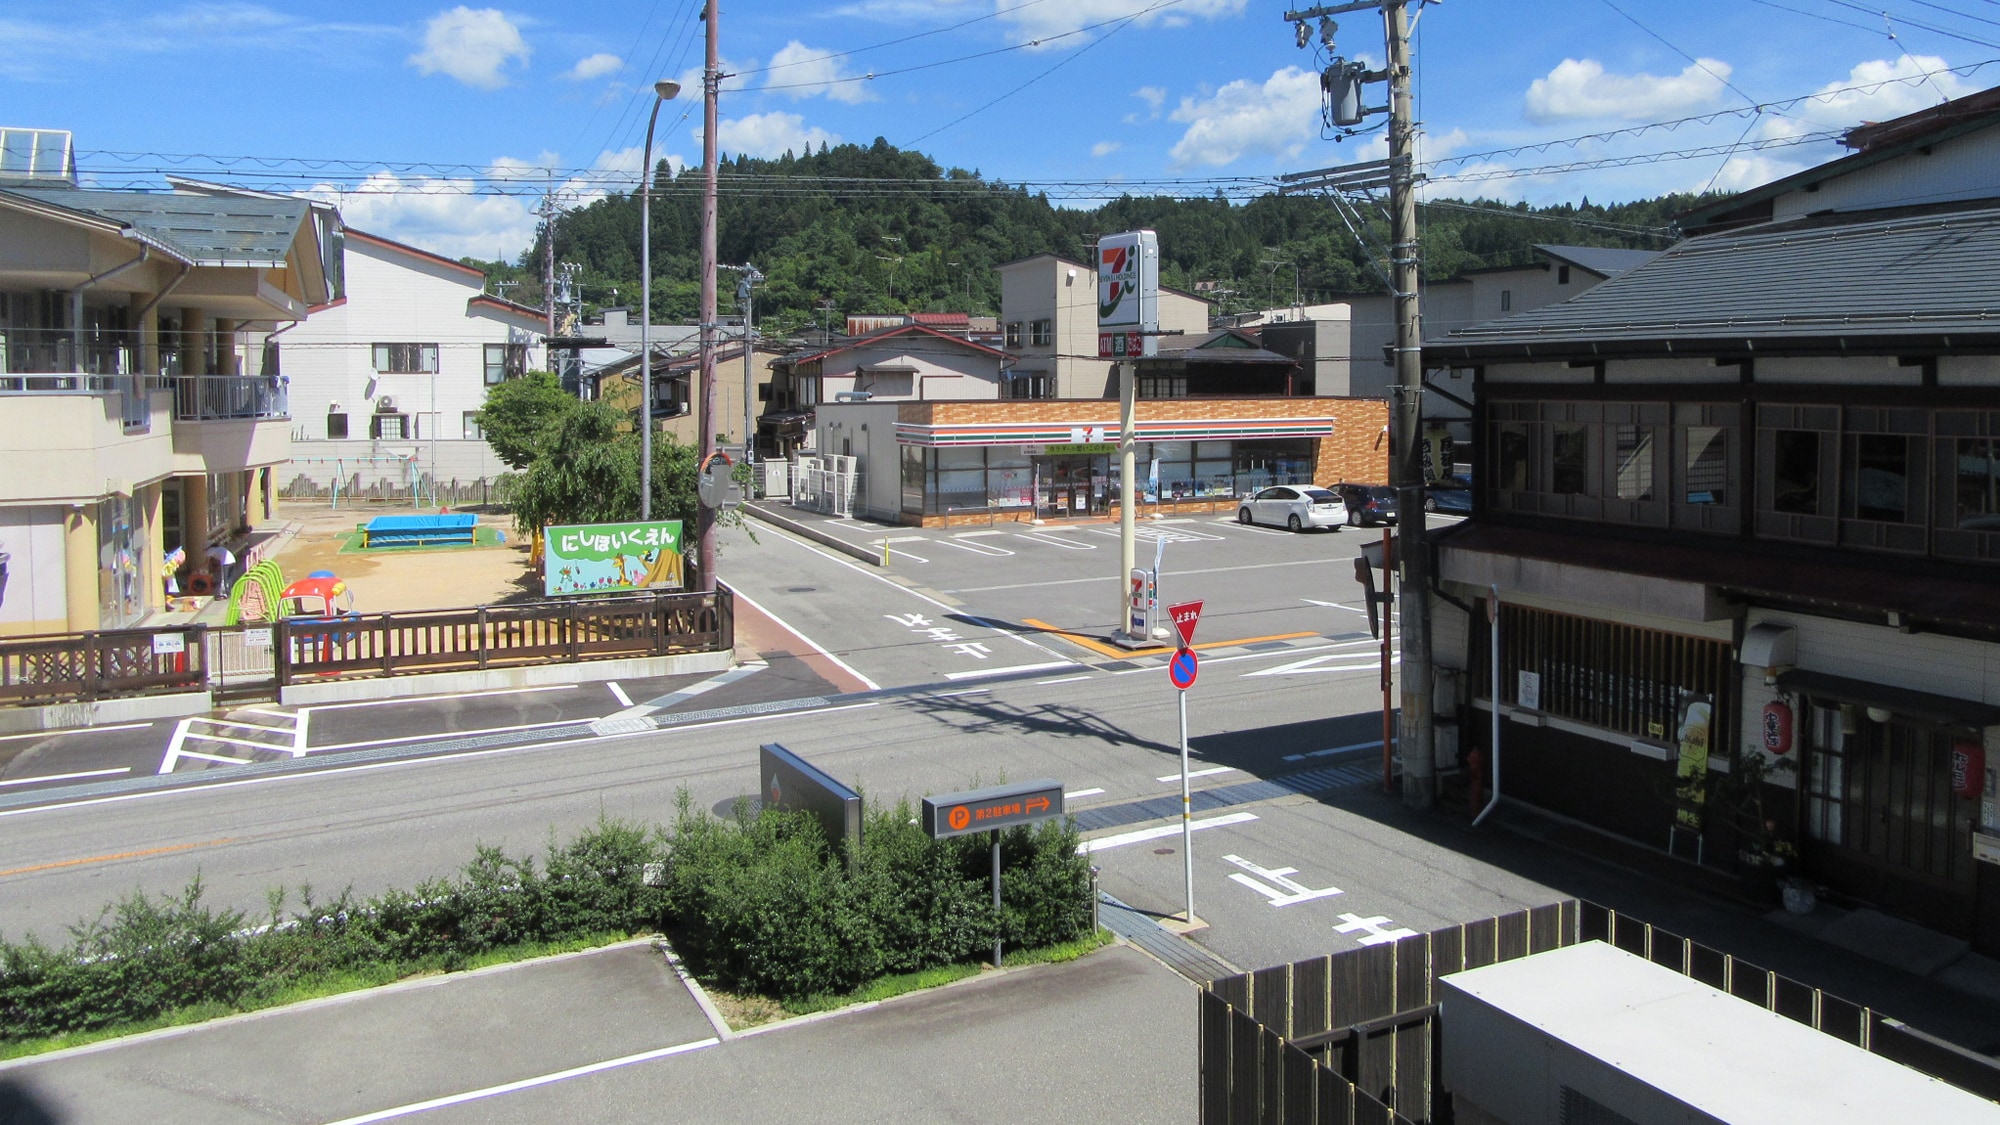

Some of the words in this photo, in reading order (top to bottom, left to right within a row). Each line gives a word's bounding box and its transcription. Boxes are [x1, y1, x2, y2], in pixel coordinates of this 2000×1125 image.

[1100, 337, 1112, 353] ATM
[1115, 336, 1125, 353] 酒
[561, 527, 675, 553] にしほいくえん
[1131, 578, 1142, 606] 7
[1176, 609, 1198, 624] 止まれ
